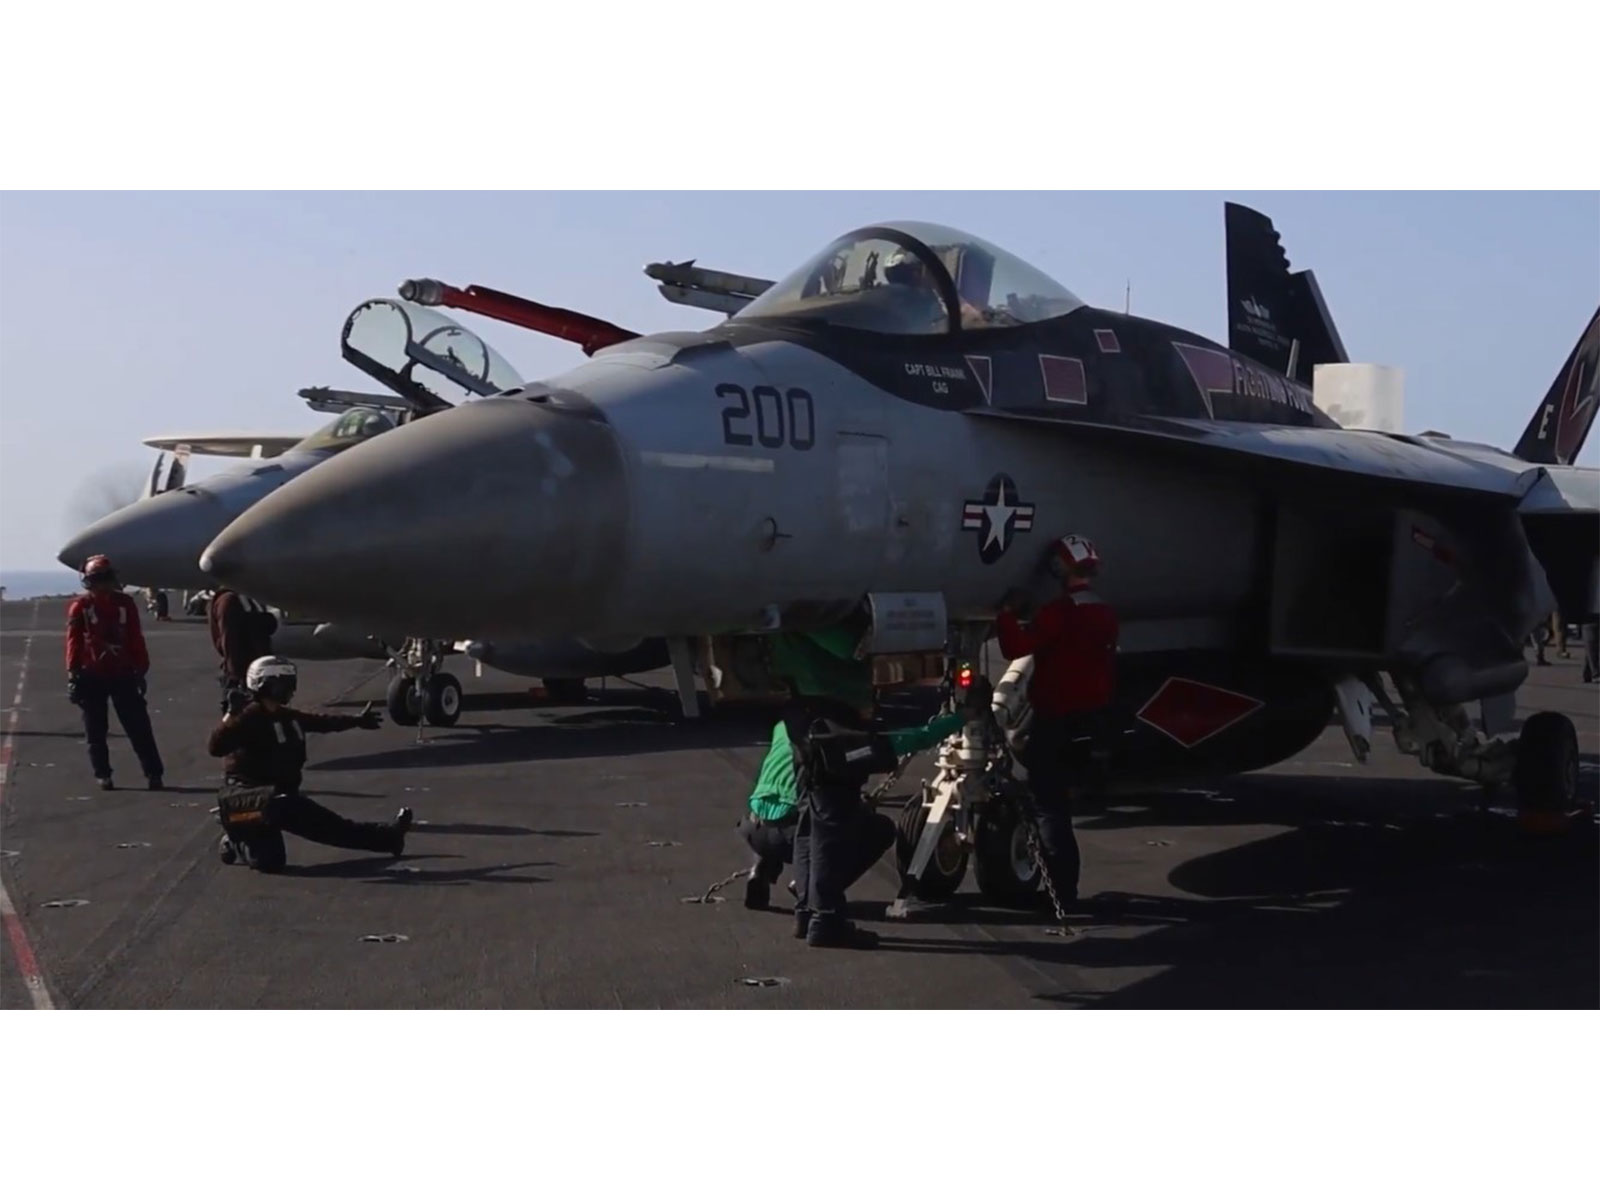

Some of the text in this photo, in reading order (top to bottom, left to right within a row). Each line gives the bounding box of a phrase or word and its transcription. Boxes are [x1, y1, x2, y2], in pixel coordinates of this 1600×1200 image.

[904, 363, 925, 376] CAPT
[925, 364, 942, 377] BILL
[714, 383, 816, 452] 200
